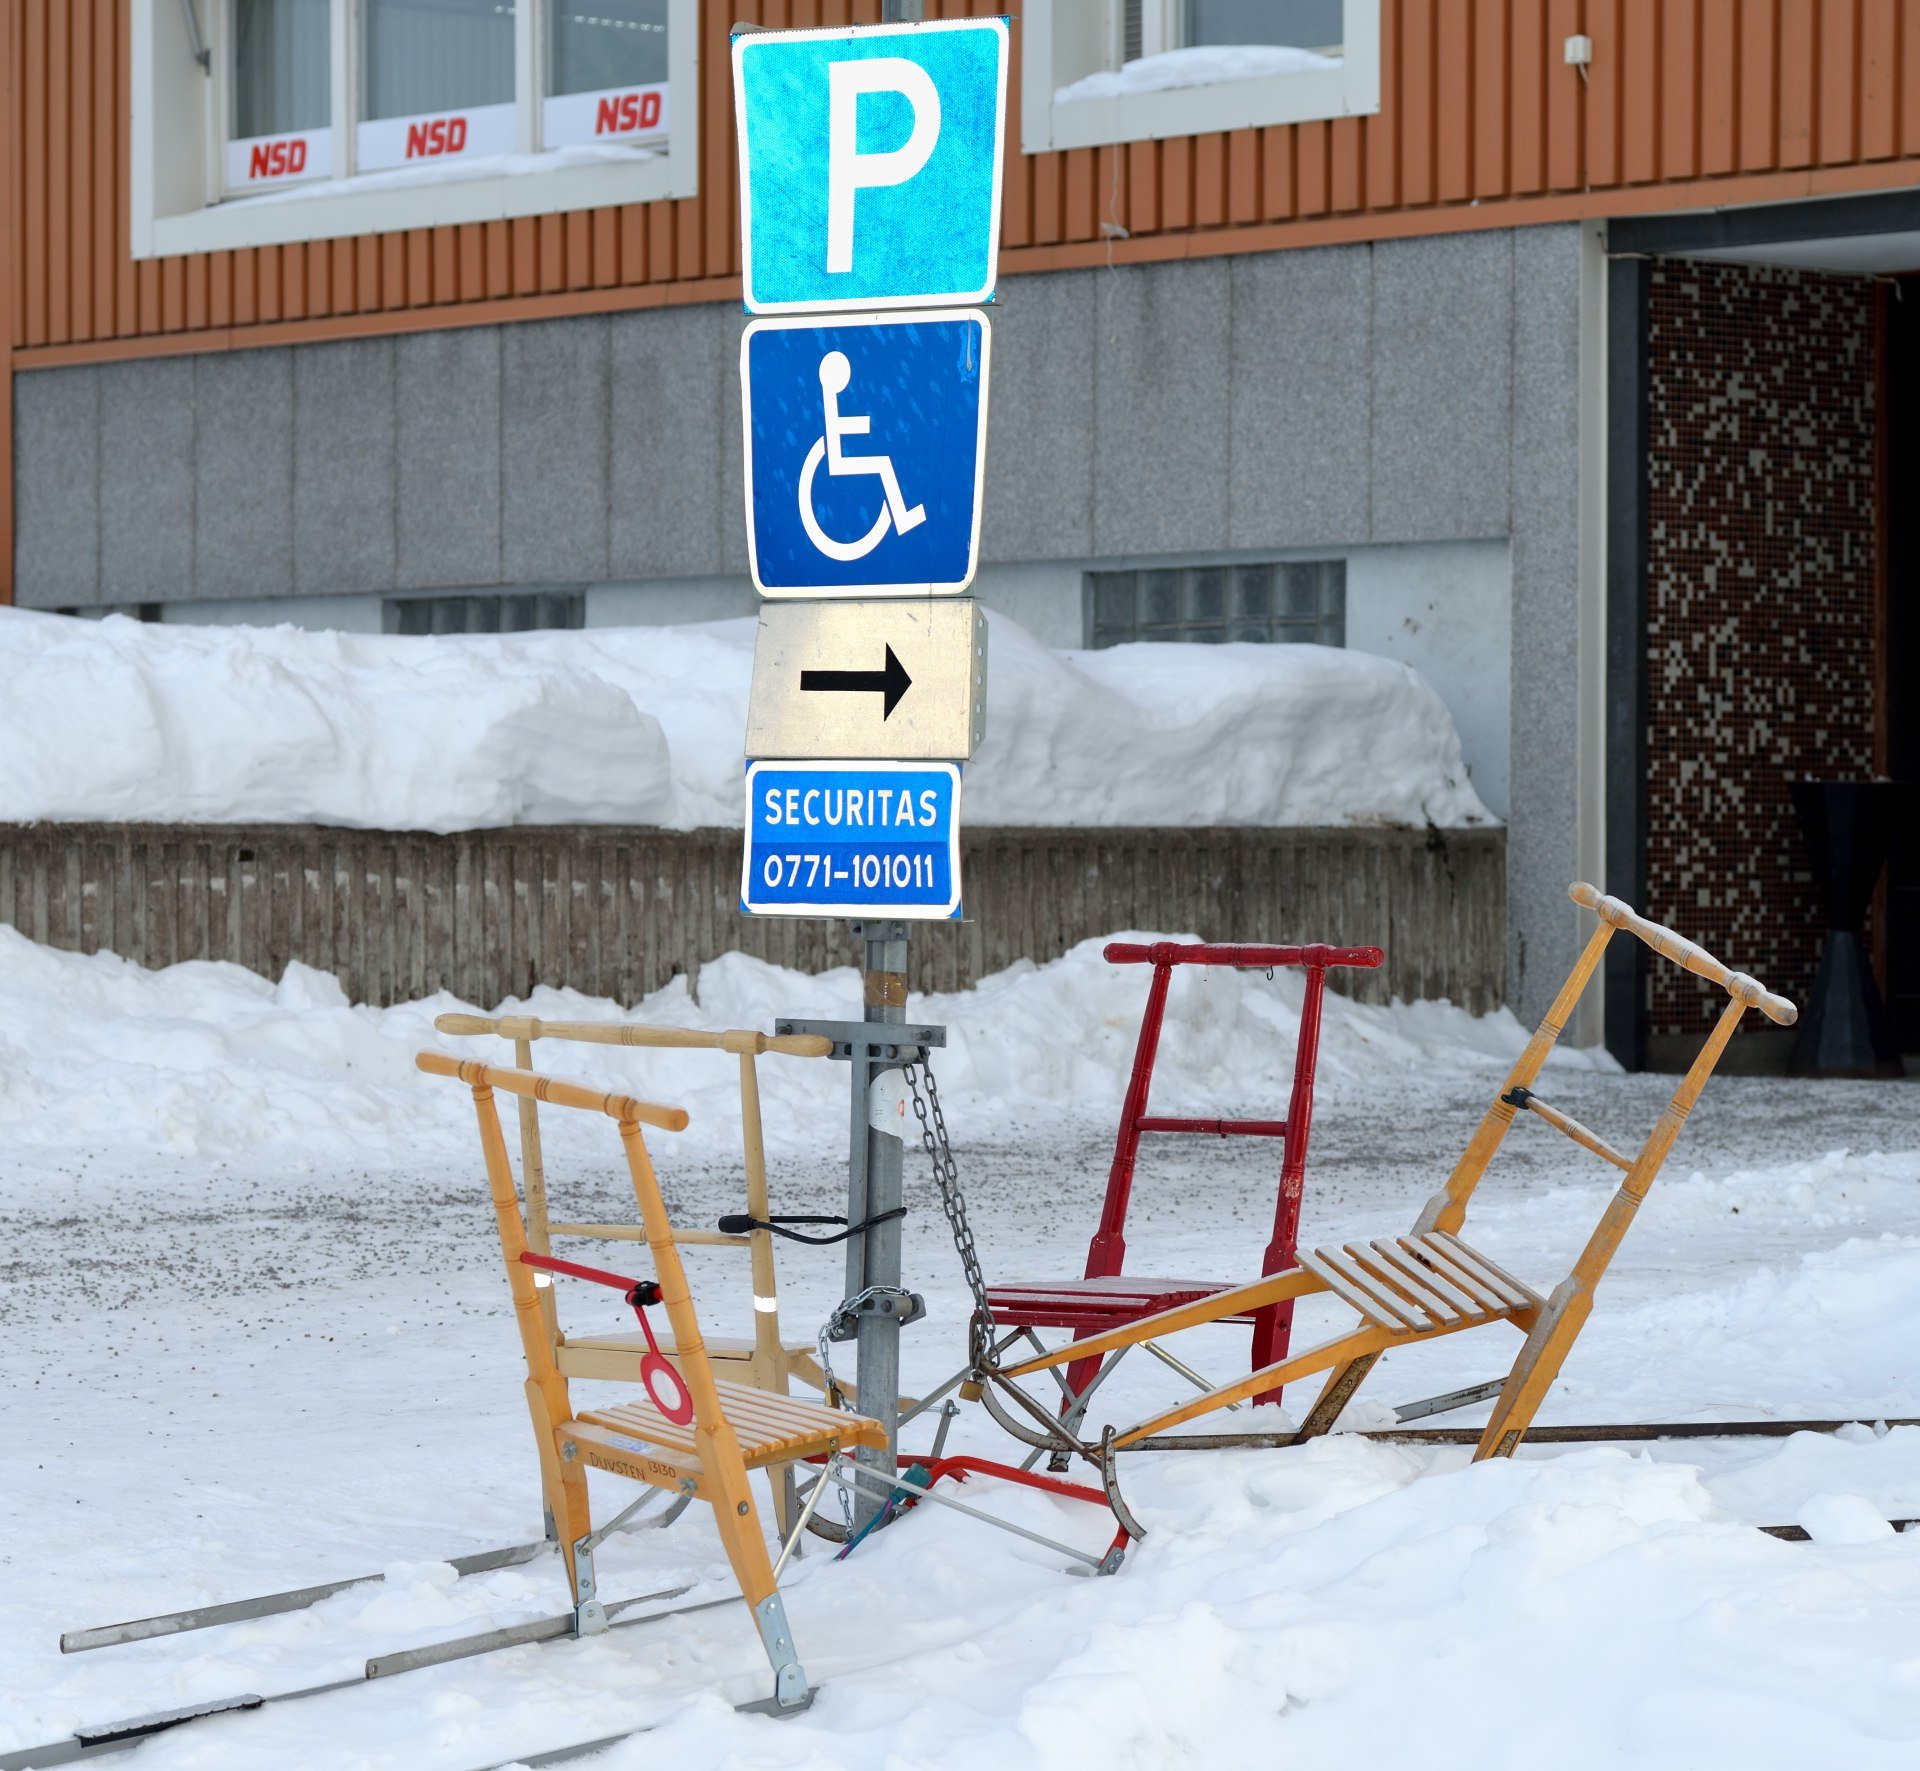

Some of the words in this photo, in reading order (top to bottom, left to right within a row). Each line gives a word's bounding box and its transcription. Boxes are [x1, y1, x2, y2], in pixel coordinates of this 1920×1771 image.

[595, 92, 661, 135] NSD
[406, 117, 467, 159] NSD
[249, 139, 307, 179] NSD
[827, 57, 941, 273] P
[765, 788, 937, 827] SECURITAS
[764, 854, 933, 888] 0771-101011
[648, 1461, 676, 1478] 13130
